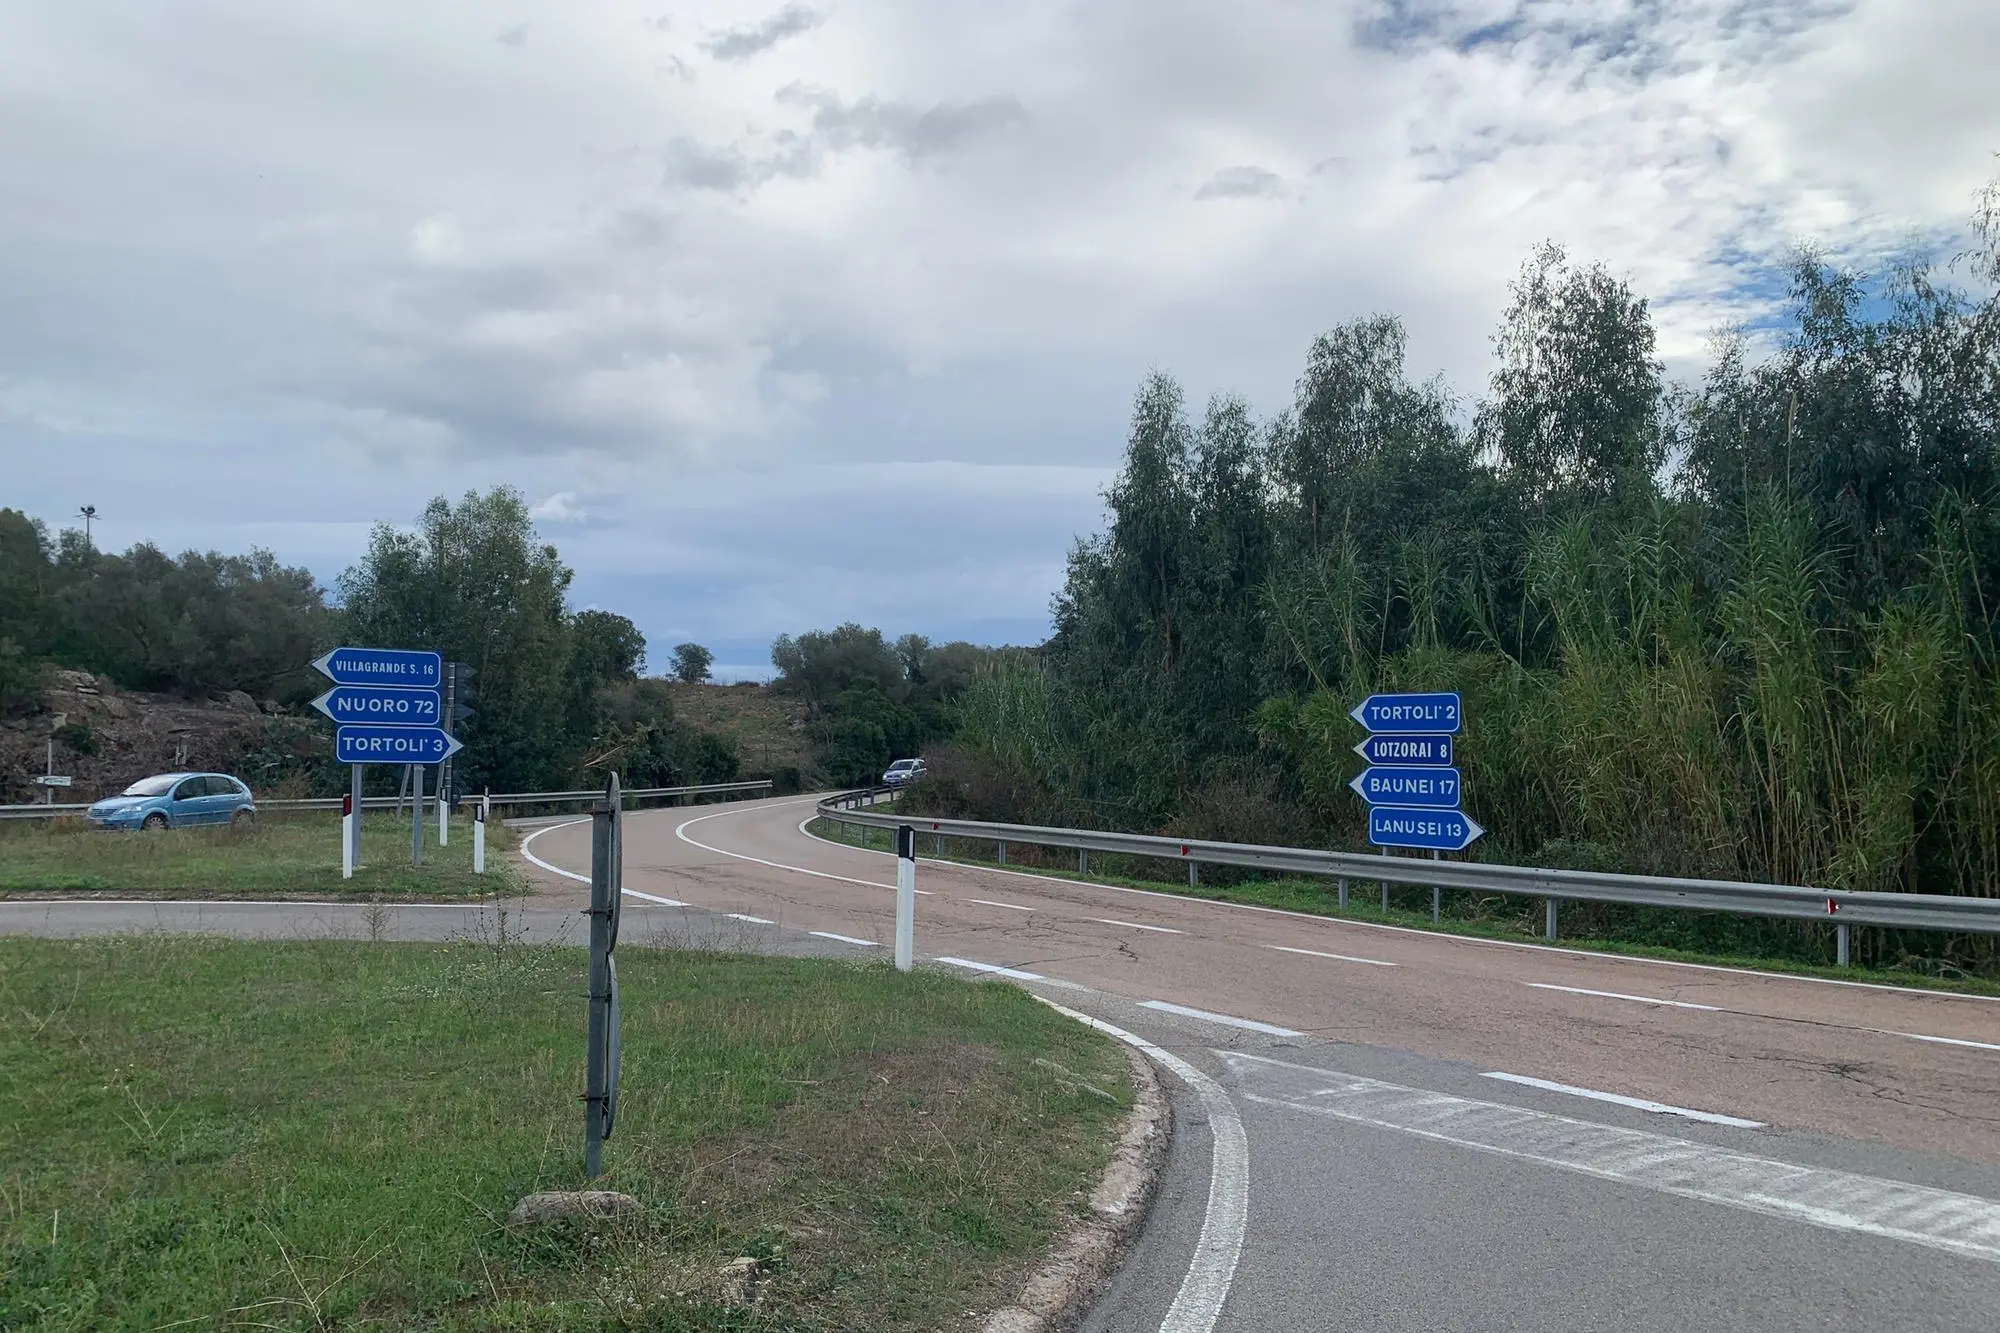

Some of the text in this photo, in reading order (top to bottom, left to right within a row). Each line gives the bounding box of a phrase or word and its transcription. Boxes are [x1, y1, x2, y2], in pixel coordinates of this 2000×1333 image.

[335, 660, 434, 675] VILLAGRANDE S. 16
[338, 697, 434, 714] NUORO 72
[1371, 705, 1455, 720] TORTOLI' 2
[343, 737, 443, 752] TORTOLI' 3
[1374, 742, 1448, 759] LOTZORAI 8
[1371, 778, 1455, 795] BAUNEI 17
[1375, 819, 1462, 837] LANUSEI 13
